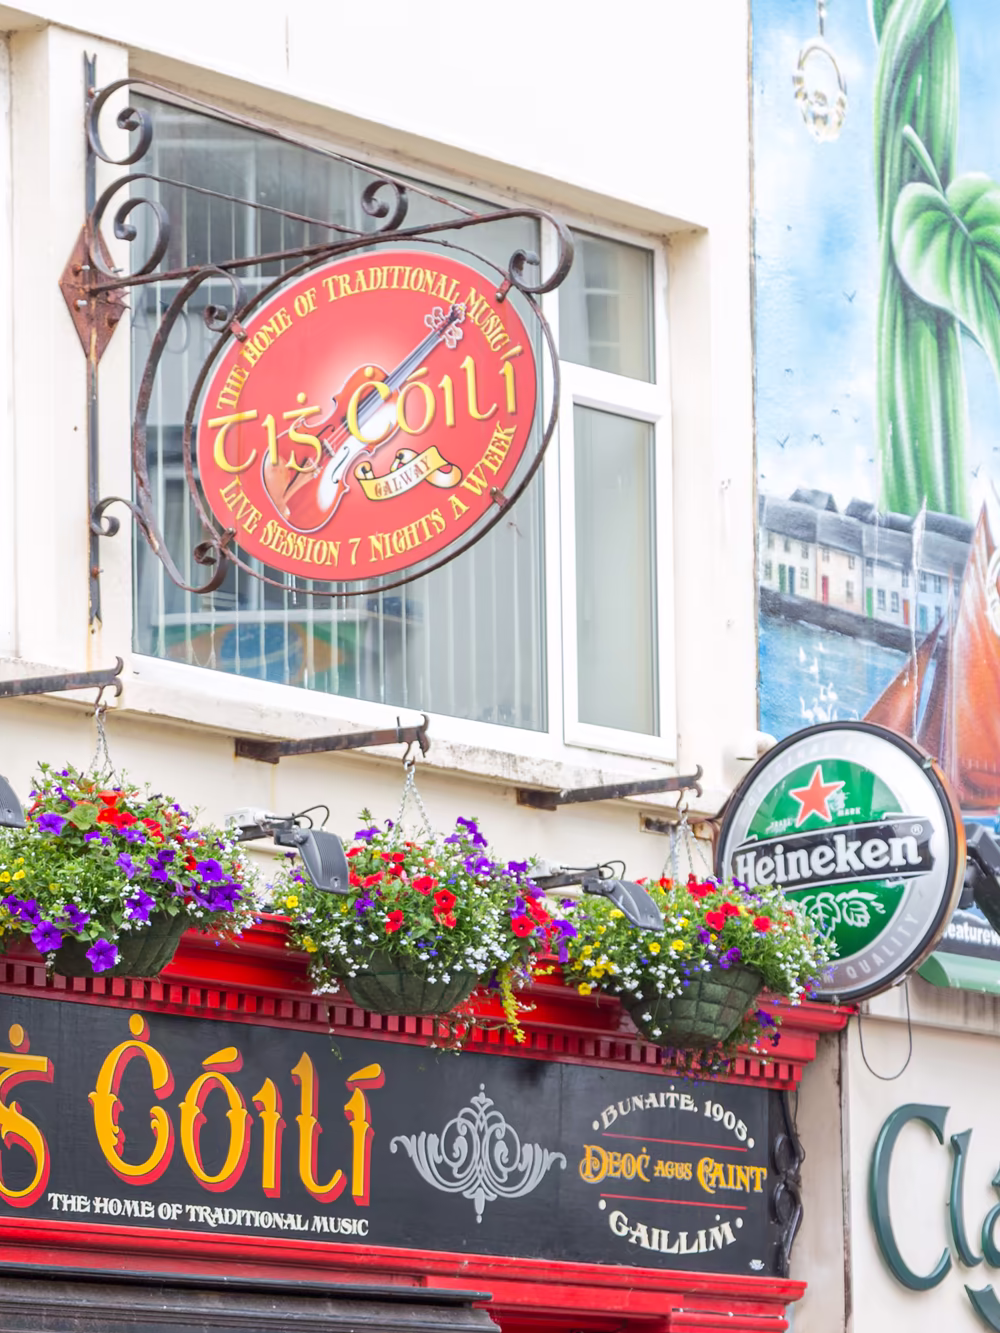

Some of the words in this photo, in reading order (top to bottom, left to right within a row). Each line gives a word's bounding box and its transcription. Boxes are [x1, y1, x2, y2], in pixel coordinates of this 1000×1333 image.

[216, 364, 250, 410] THE
[240, 307, 293, 368] HOME
[294, 287, 318, 318] OF
[322, 265, 460, 304] TRADITIONAL
[464, 287, 510, 352] MUSIC
[219, 475, 263, 534] LIVE
[259, 519, 341, 567] SESSION
[348, 538, 361, 566] 7
[368, 508, 446, 563] NIGHTS
[448, 494, 470, 521] A
[460, 420, 517, 497] WEEK
[374, 456, 431, 498] GALWAY
[736, 833, 923, 887] Heineken
[846, 912, 919, 979] QUALITY
[654, 1160, 692, 1181] AGUS
[48, 1192, 91, 1214] THE
[92, 1196, 154, 1219] HOME
[158, 1203, 183, 1221] OF
[186, 1204, 309, 1232] TRADITIONAL
[311, 1215, 369, 1236] MUSIC
